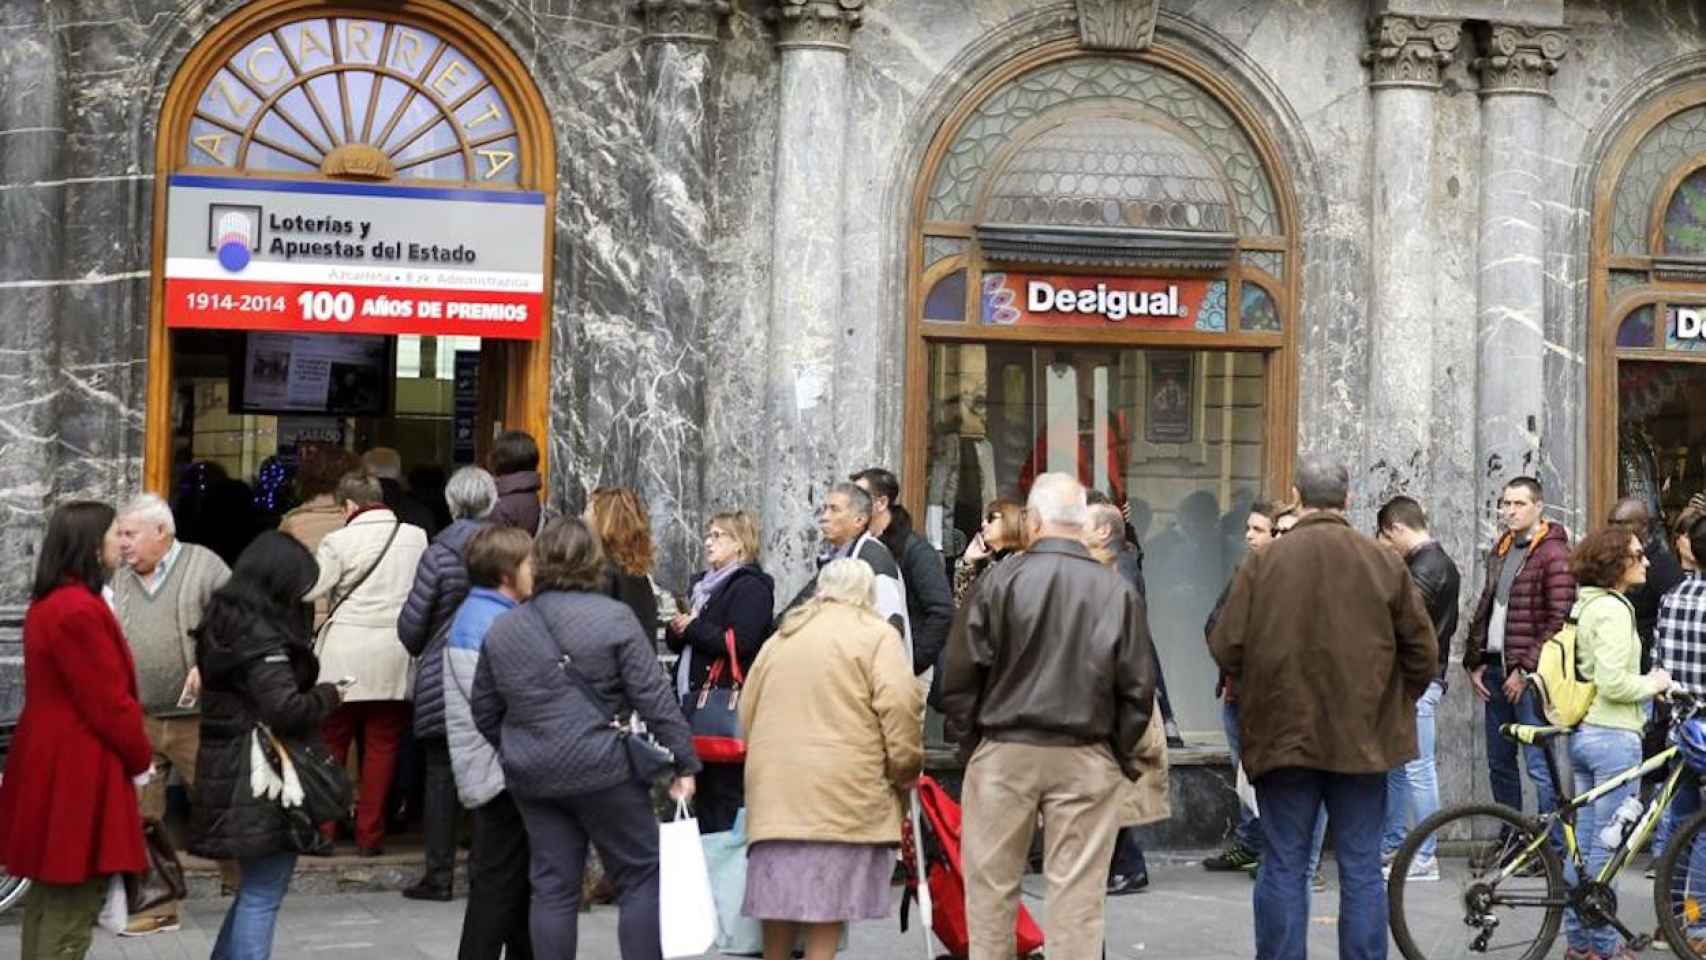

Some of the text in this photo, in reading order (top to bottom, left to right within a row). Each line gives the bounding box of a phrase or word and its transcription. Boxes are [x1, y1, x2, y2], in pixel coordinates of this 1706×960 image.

[193, 20, 515, 179] AZCARRETA
[269, 212, 371, 240] Loterías y
[269, 237, 477, 263] Apuestas del Estado
[185, 290, 528, 322] 1914-2014 100 AÑOS DE PREMIOS
[1028, 280, 1179, 321] Desigual
